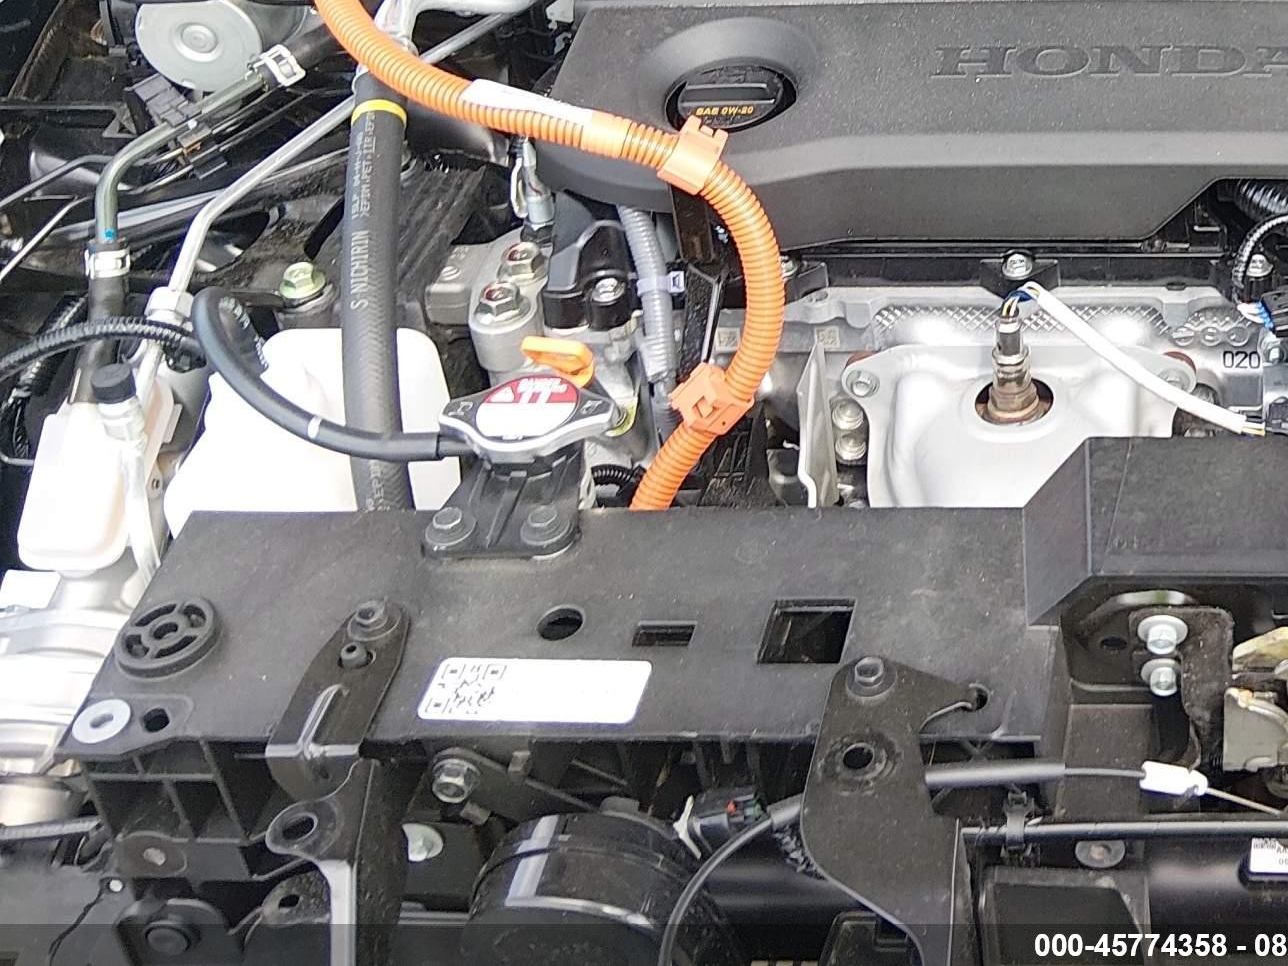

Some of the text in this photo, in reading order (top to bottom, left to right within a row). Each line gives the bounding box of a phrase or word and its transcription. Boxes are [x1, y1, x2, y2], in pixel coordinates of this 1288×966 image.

[696, 105, 754, 116] SAE 0W-20
[1223, 350, 1260, 369] 020
